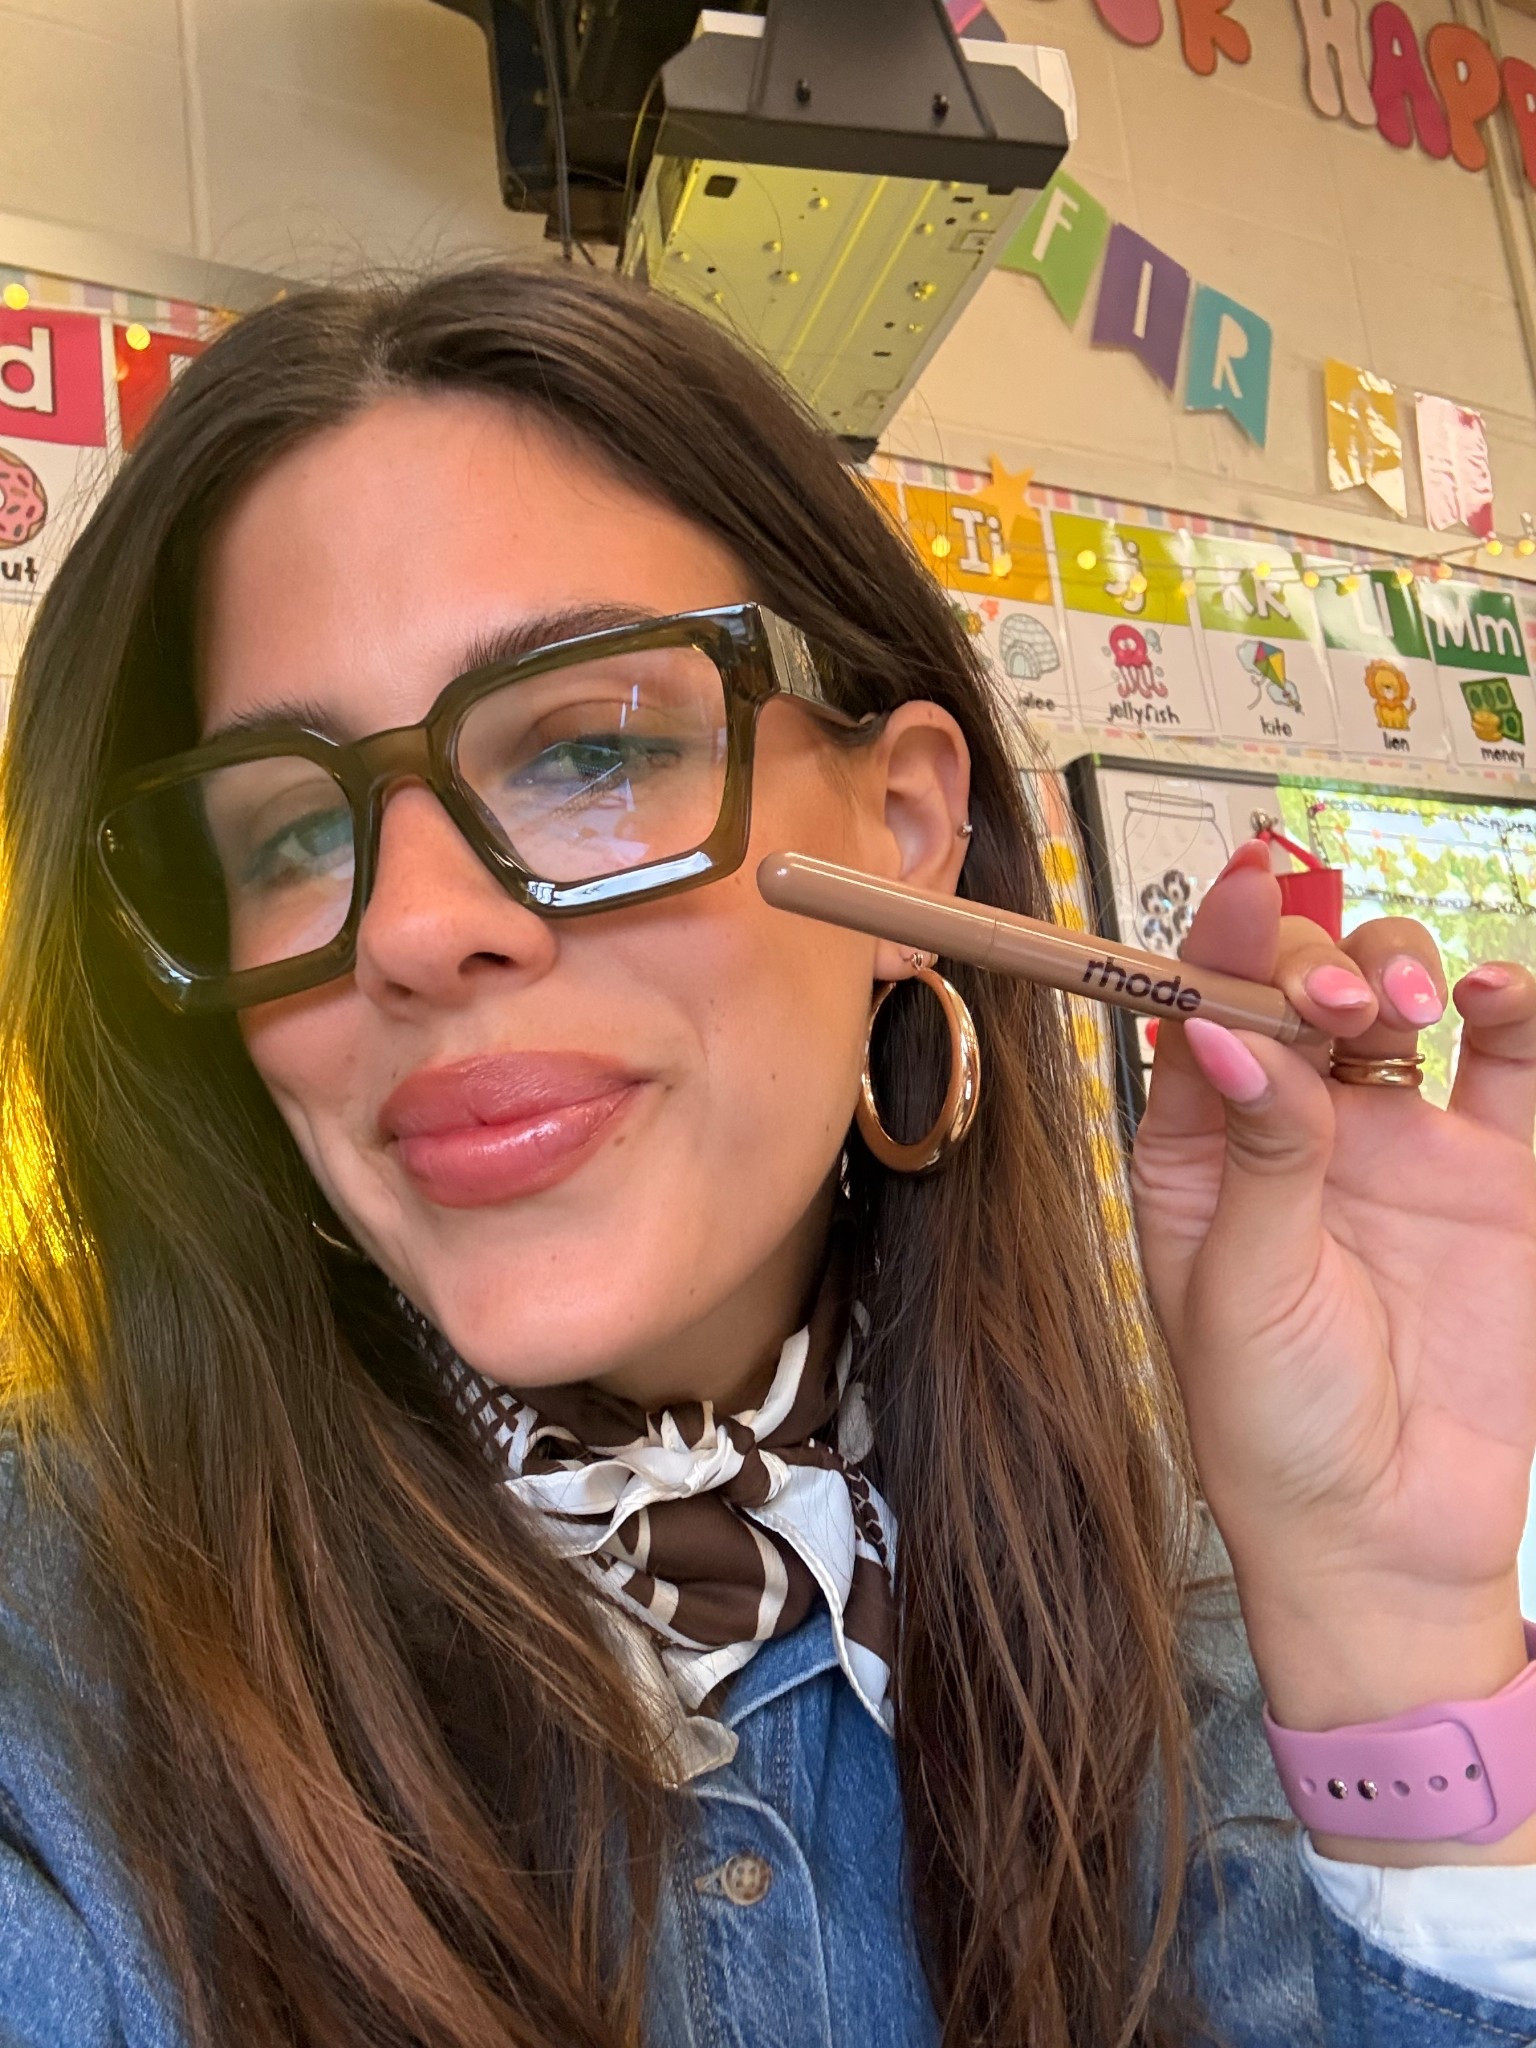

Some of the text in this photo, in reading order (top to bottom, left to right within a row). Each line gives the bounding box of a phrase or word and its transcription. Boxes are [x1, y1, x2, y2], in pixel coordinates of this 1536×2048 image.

[951, 507, 1008, 576] Ii
[1422, 581, 1521, 658] Mm
[1107, 700, 1180, 729] jellyfish
[1260, 716, 1292, 737] kite
[1480, 747, 1525, 768] money
[1082, 957, 1201, 1011] rhode
